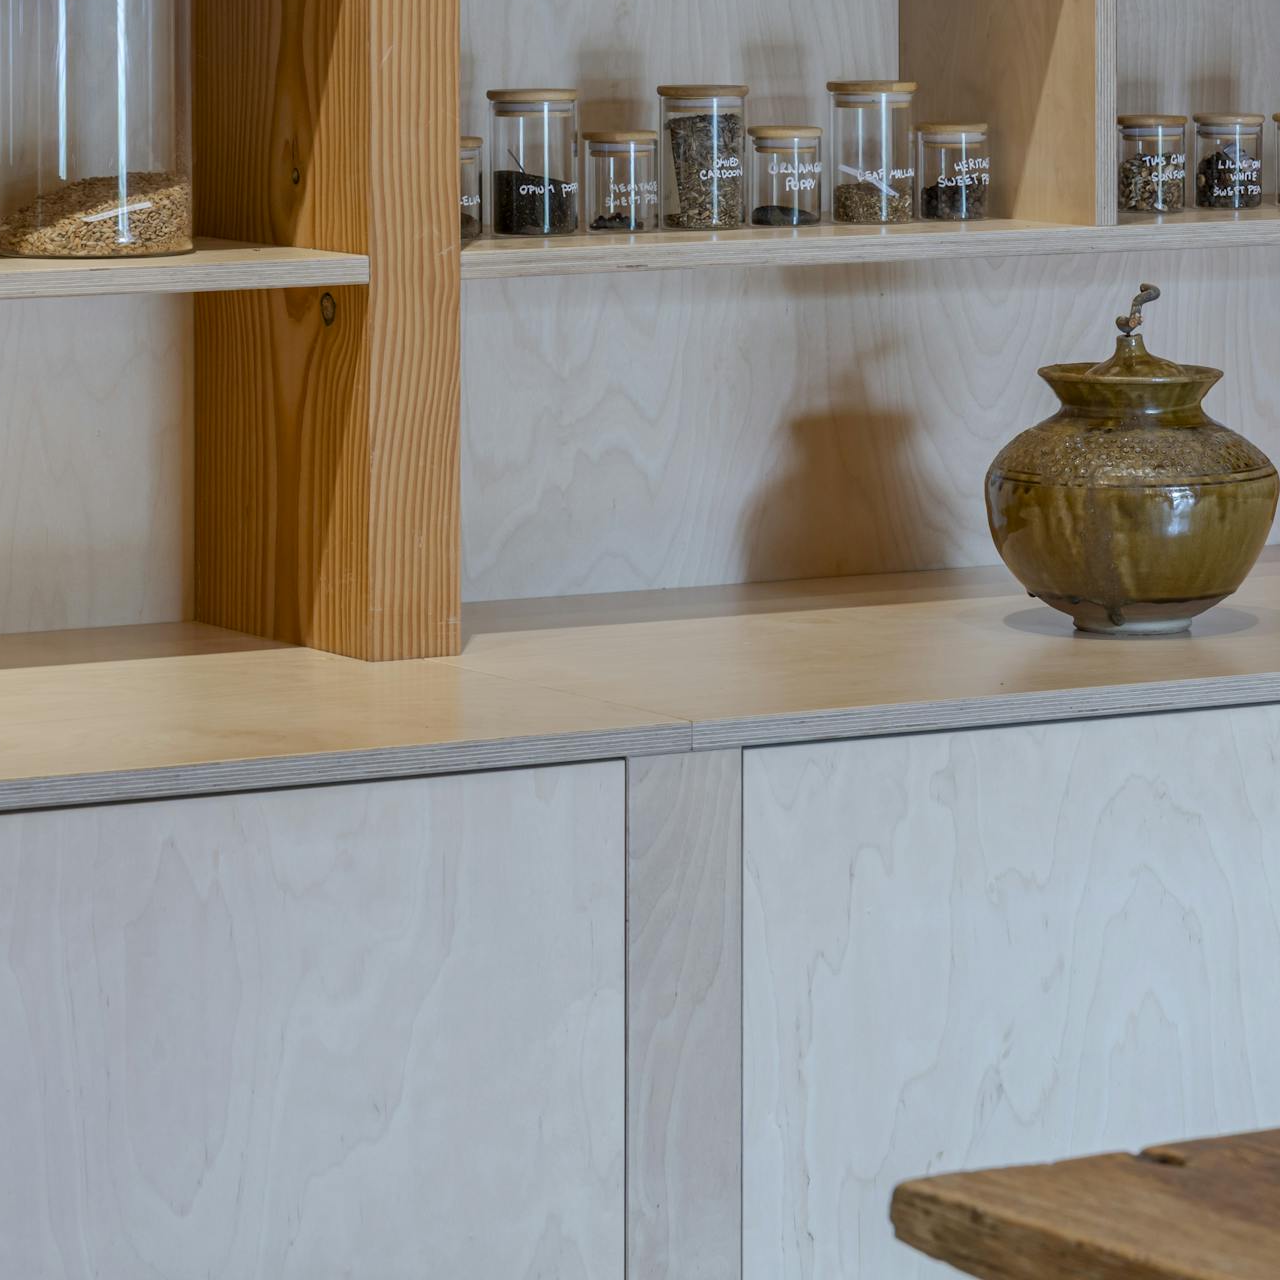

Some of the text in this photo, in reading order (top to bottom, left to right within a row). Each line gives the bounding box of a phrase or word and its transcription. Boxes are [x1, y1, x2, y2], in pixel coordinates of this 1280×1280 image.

[785, 176, 816, 191] POPPY
[937, 173, 979, 188] SWEET
[519, 183, 555, 195] OPIUM
